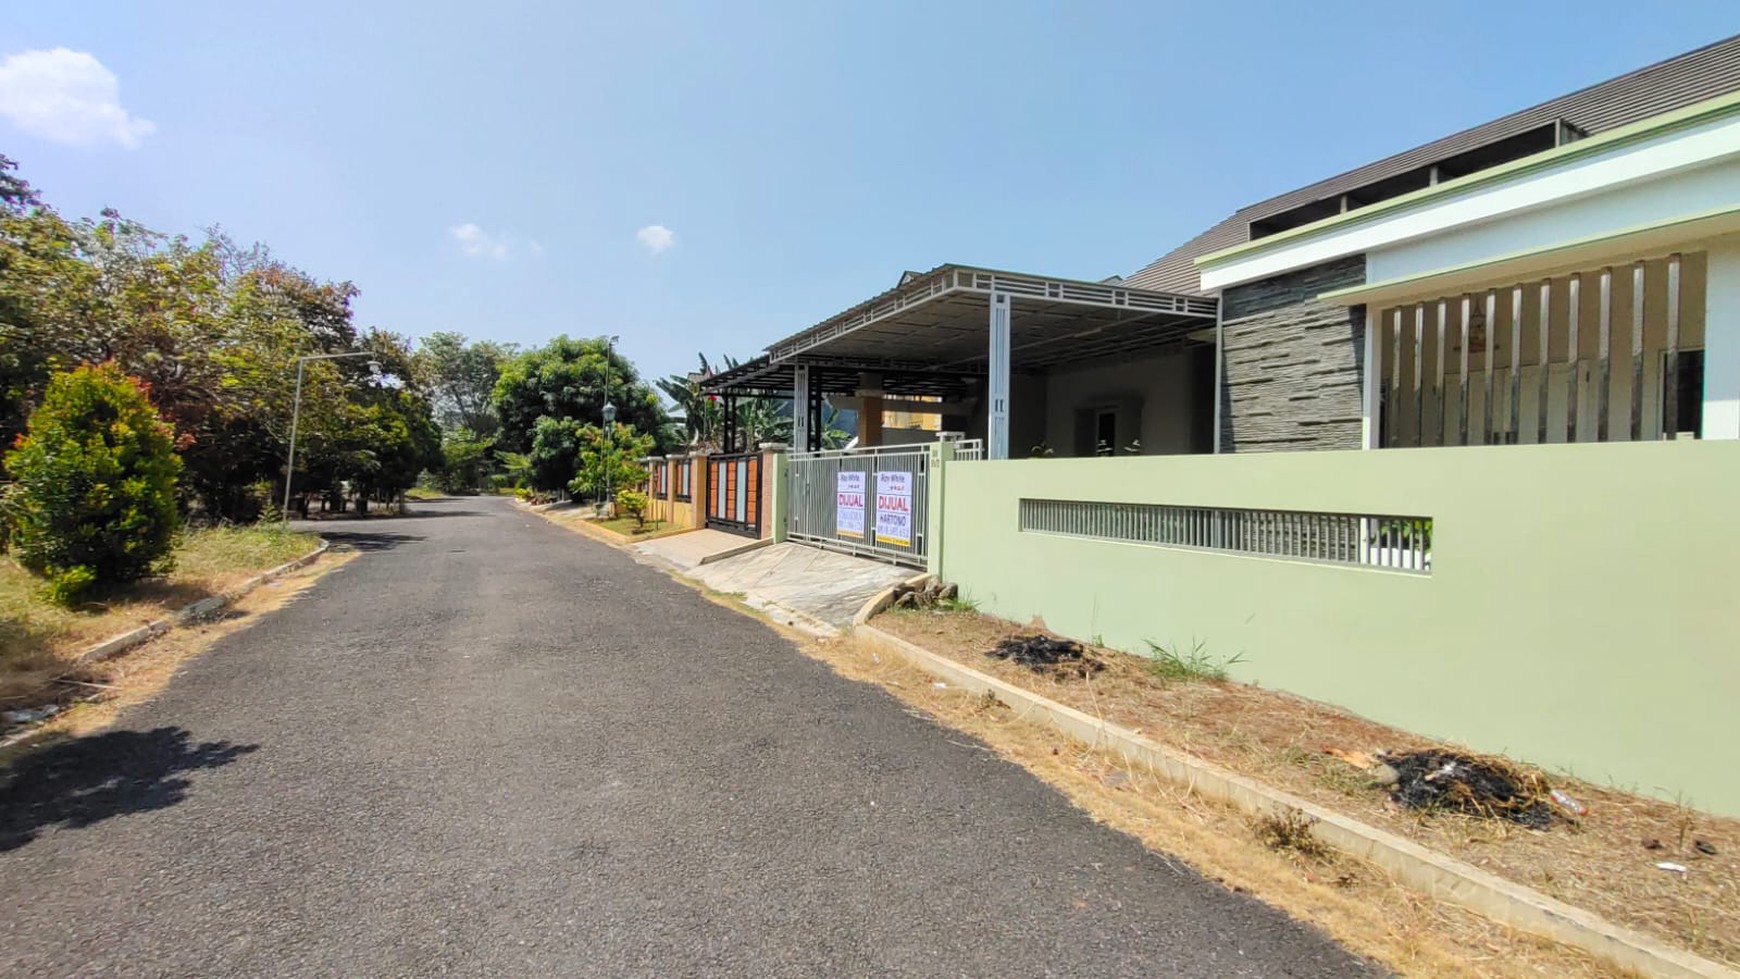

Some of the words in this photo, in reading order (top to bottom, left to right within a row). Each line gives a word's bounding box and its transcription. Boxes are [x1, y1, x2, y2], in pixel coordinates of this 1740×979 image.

[891, 474, 905, 483] White
[839, 494, 863, 508] DIJUAL
[878, 495, 909, 512] DIJUAL
[880, 513, 907, 527] HARTONO
